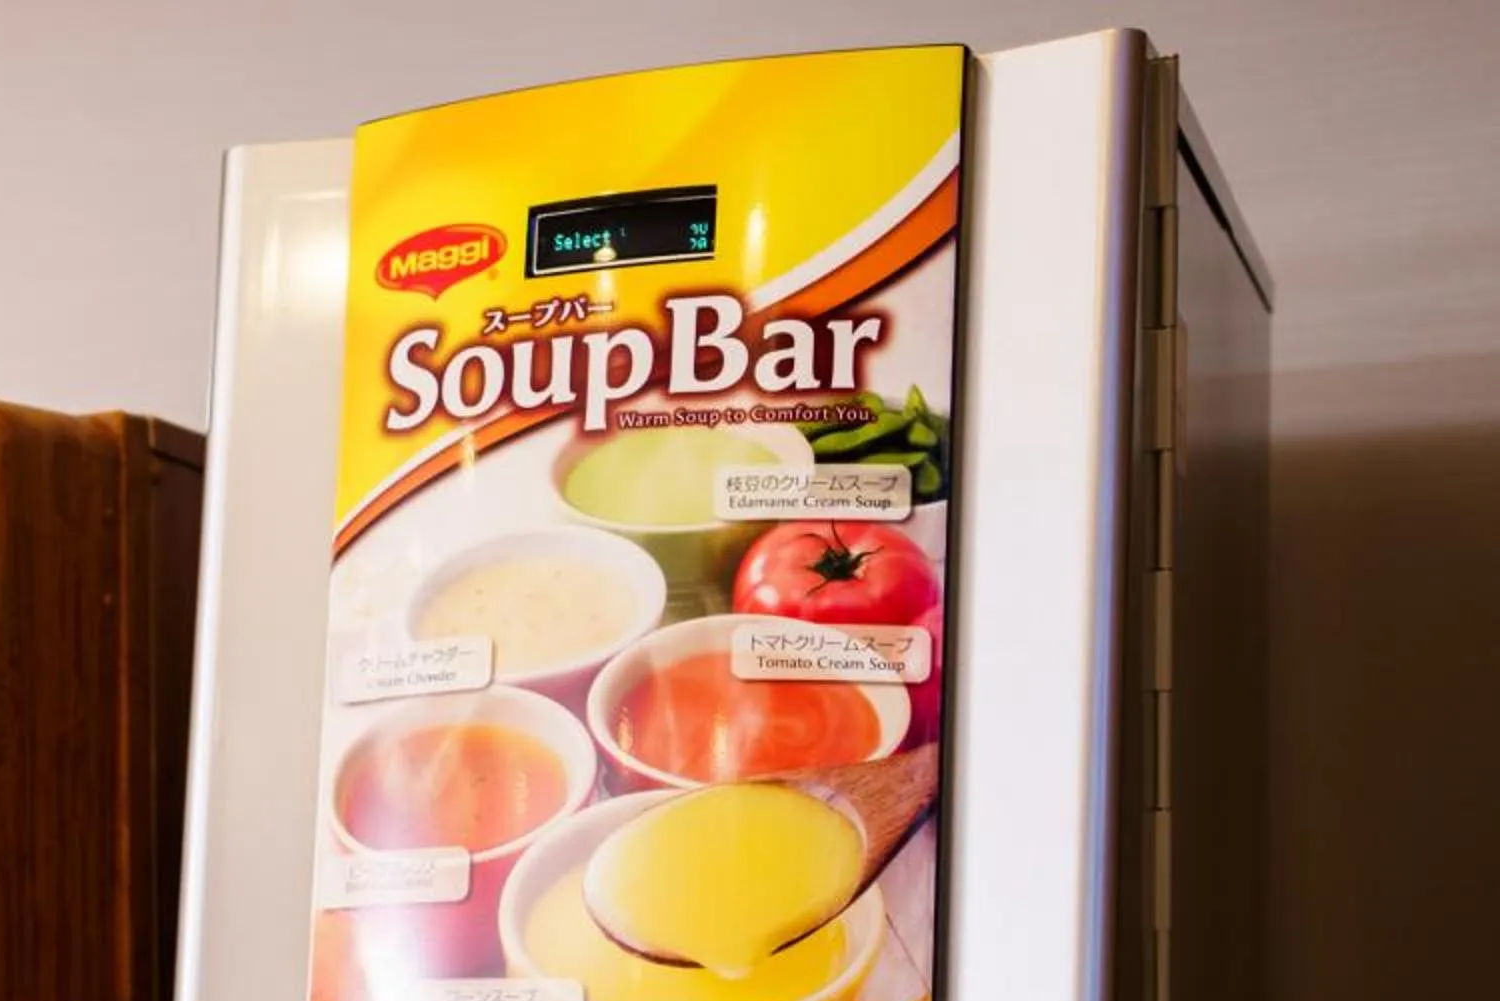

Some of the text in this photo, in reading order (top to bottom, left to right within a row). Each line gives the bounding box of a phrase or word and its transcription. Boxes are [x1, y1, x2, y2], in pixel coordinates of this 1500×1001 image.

[554, 230, 611, 250] Select
[389, 235, 489, 280] Maggi
[483, 298, 613, 334] スープバー
[619, 411, 668, 428] Warm
[675, 408, 718, 427] Soup
[726, 407, 745, 422] to
[752, 405, 828, 421] Comfort
[726, 475, 898, 493] 枝豆のクリームスープ
[729, 496, 892, 510] Edamame Cream Soup
[751, 634, 914, 655] トマトクリームスープ
[757, 656, 906, 675] Tomato Cream Soup
